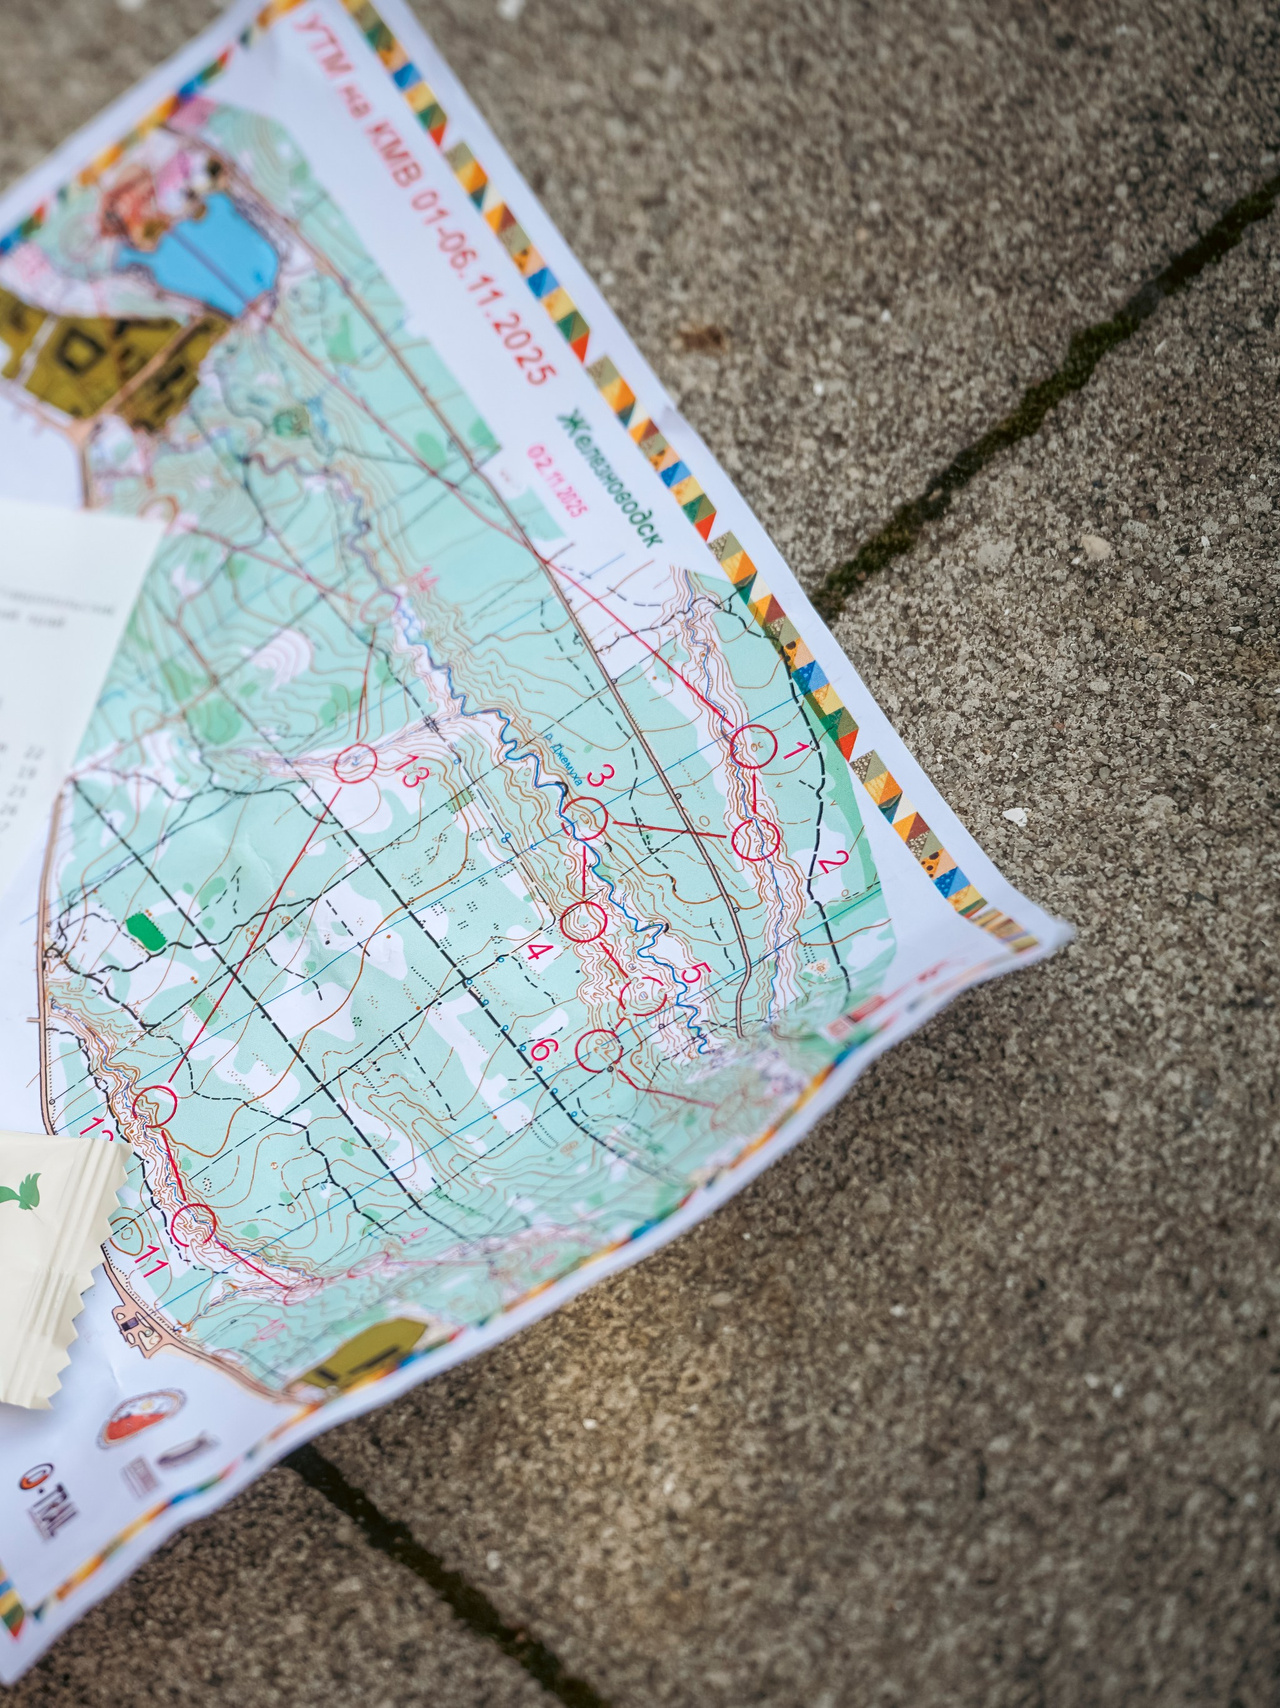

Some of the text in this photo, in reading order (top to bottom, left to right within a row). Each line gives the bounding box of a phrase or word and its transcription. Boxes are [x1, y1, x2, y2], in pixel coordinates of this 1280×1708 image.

[337, 83, 372, 119] на
[368, 121, 426, 188] КМВ
[410, 190, 558, 386] 01-06.11.2025
[526, 444, 588, 518] 02.11.2025
[557, 406, 664, 548] Железноводск
[549, 742, 583, 787] Джемуха
[783, 741, 812, 760] 1
[394, 754, 430, 788] 13
[587, 763, 615, 788] 3
[818, 849, 850, 875] 2
[526, 942, 555, 961] 4
[681, 961, 712, 984] 5
[530, 1037, 560, 1062] 6
[133, 1245, 169, 1278] 11
